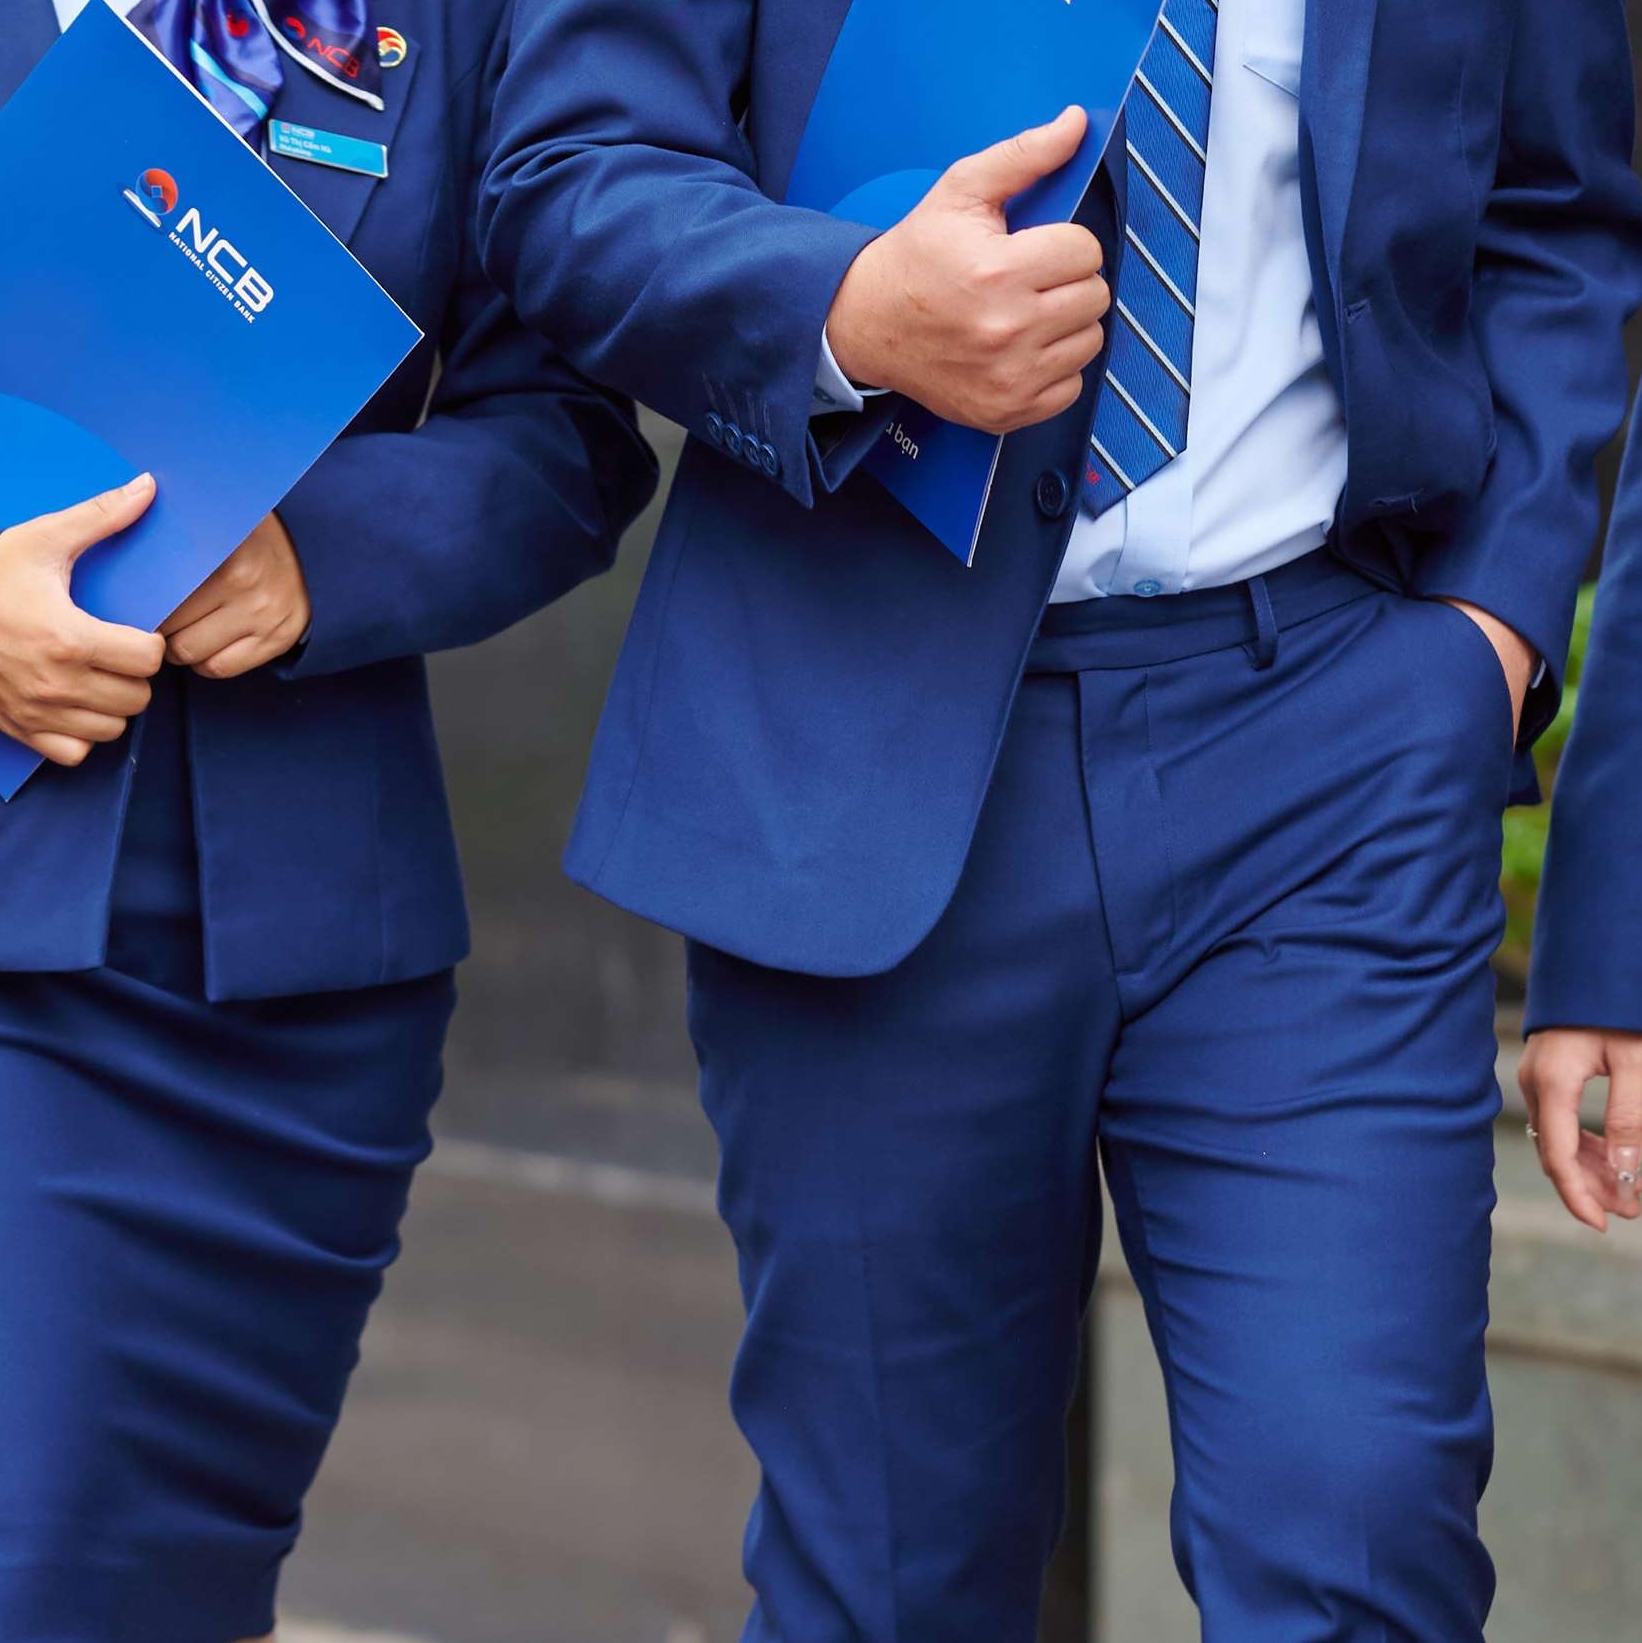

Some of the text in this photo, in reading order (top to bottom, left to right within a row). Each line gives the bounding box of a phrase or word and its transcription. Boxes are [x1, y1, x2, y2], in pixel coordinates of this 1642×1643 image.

[307, 37, 360, 78] NCB
[168, 232, 255, 324] NATIONAL CITIZEN BANK
[175, 207, 274, 313] NCB
[894, 423, 919, 460] bạn
